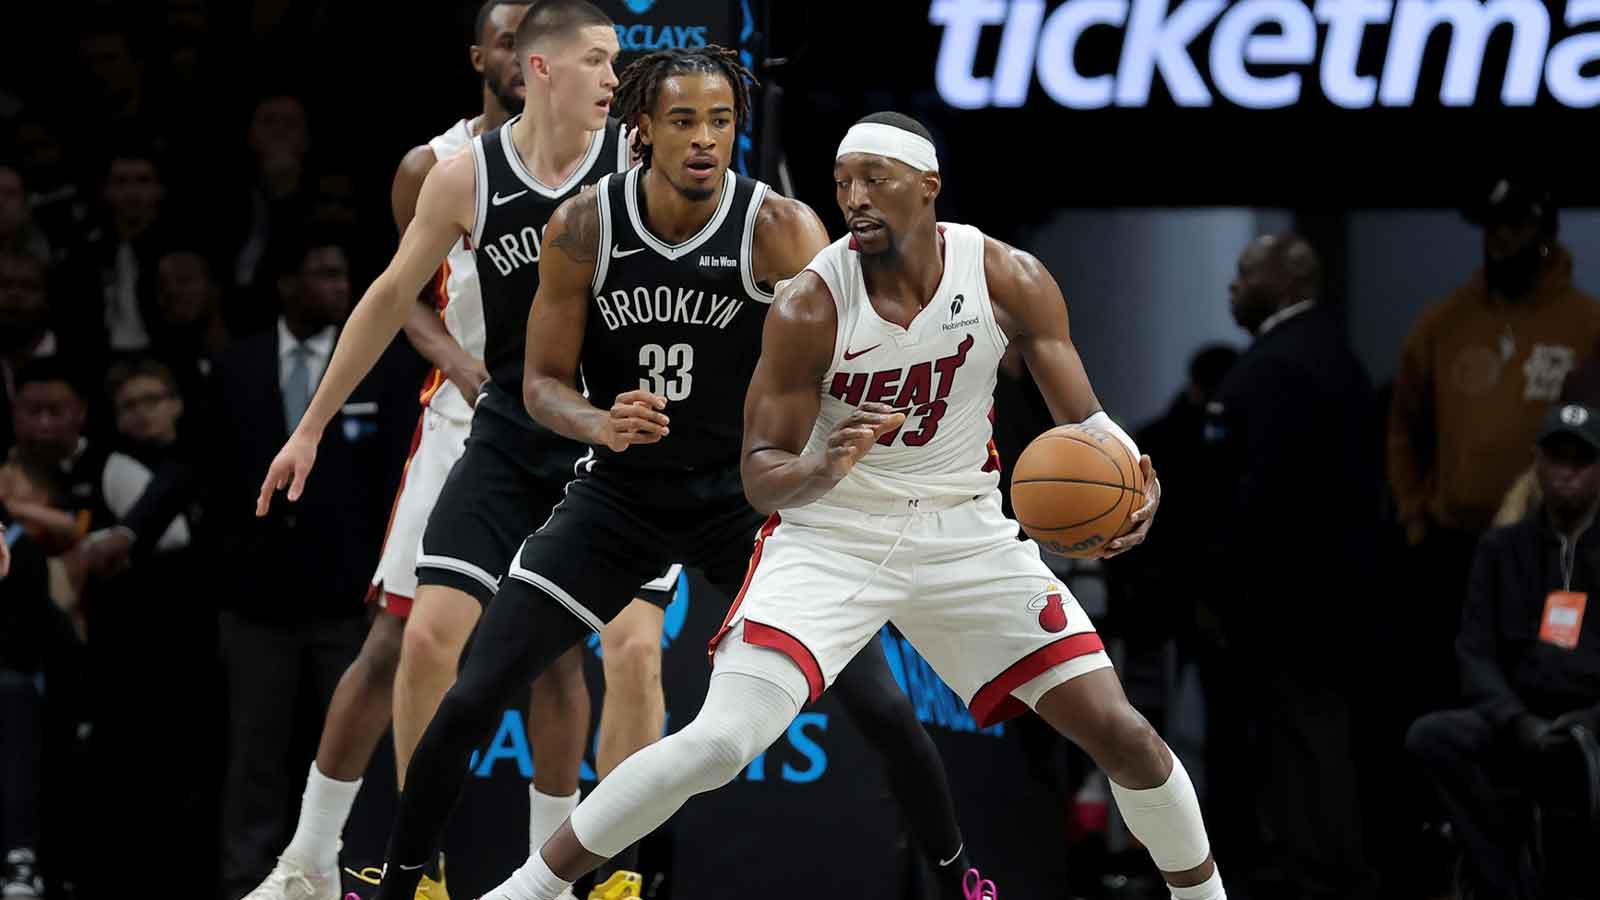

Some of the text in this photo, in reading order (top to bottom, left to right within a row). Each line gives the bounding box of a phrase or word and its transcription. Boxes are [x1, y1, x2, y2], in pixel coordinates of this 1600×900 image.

[484, 224, 546, 276] BRO
[699, 255, 737, 267] All In Won
[597, 286, 744, 331] BROOKLYN
[942, 316, 979, 331] Robinhood
[638, 343, 695, 402] 33
[829, 333, 974, 408] HEAT
